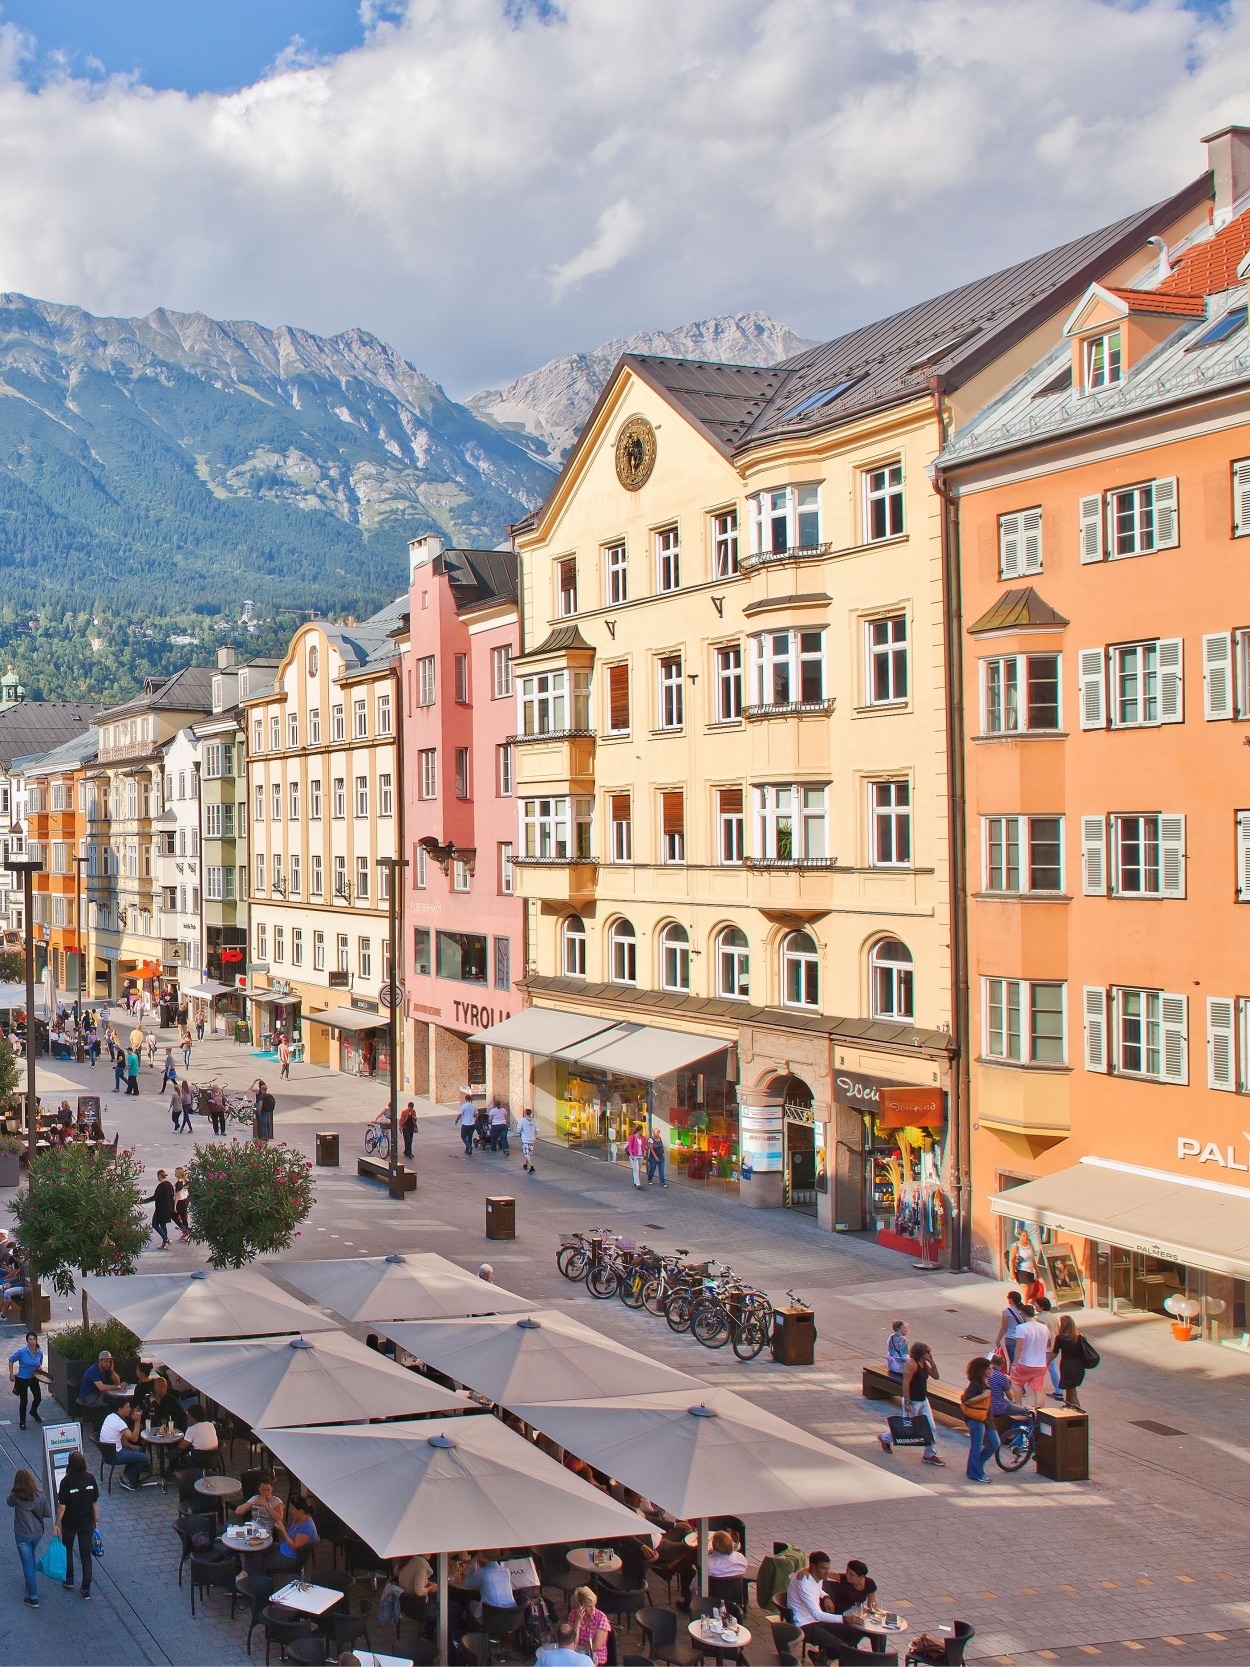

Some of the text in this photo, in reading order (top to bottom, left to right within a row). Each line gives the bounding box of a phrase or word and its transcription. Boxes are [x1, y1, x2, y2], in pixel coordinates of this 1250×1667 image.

[1177, 1136, 1250, 1173] PAL
[1136, 1244, 1179, 1261] PALMERS
[50, 1437, 77, 1445] Heineken
